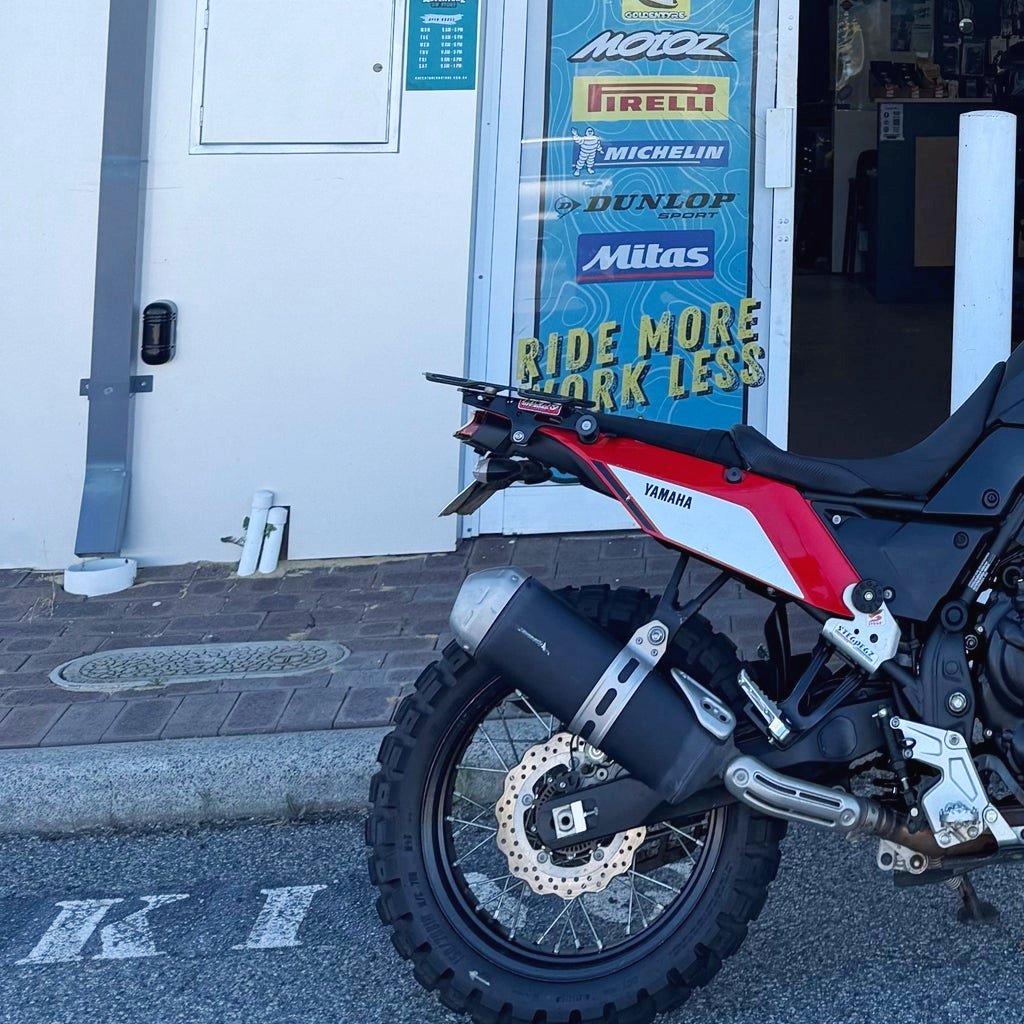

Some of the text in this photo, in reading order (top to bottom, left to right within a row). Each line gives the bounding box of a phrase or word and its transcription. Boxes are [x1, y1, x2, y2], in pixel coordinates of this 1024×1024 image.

[624, 10, 687, 19] GOLDENTYRE
[567, 30, 737, 63] MOTOZ
[588, 83, 716, 112] PIRELLI
[603, 145, 725, 162] MICHELIN
[583, 192, 736, 213] DUNLOP
[657, 211, 719, 220] SPORT
[582, 243, 710, 272] Mitas
[516, 297, 762, 383] RIDE MORE
[668, 341, 766, 401] LESS
[644, 482, 693, 510] YAMAHA
